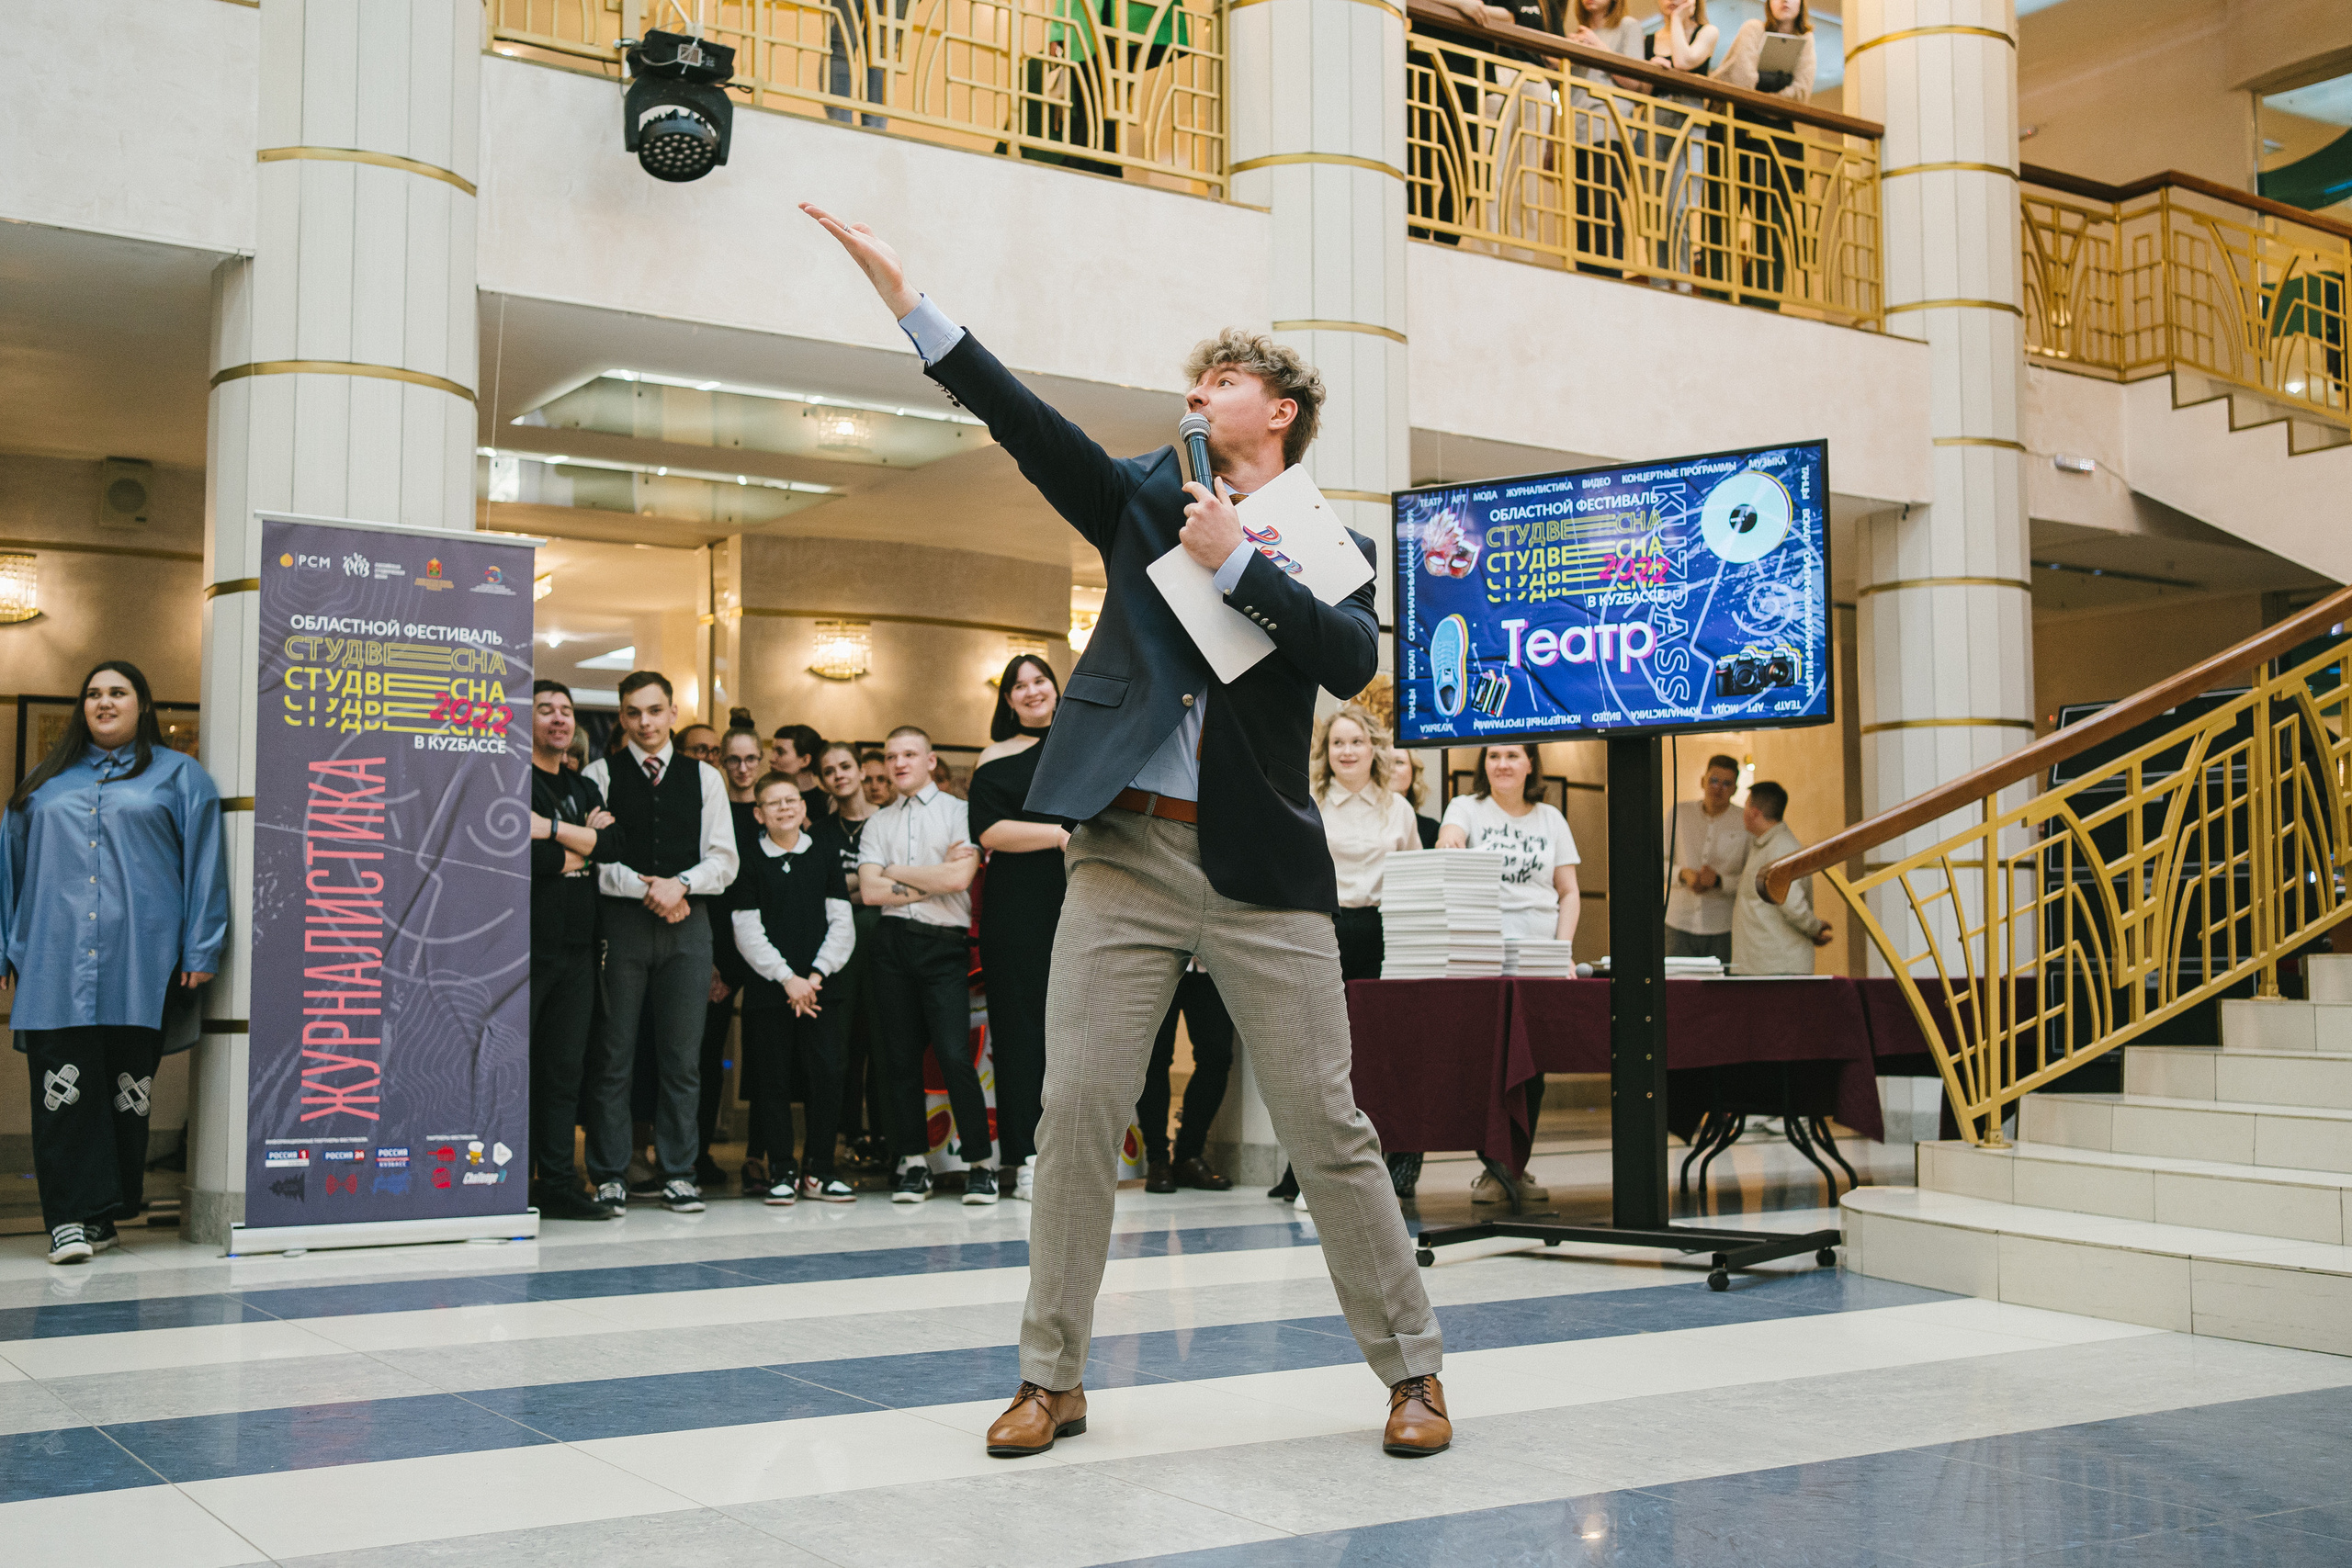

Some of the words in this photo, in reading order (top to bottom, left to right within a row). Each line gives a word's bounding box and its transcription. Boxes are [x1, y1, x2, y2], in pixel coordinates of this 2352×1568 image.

[1419, 497, 1443, 507] ТЕАТР
[1451, 494, 1466, 504] АРТ
[1473, 491, 1498, 502] МОДА
[1506, 481, 1573, 498] ЖУРНАЛИСТИКА
[1582, 477, 1611, 489] ВИДЕО
[1622, 469, 1679, 484] КОНЦЕРТНЫЕ
[1680, 461, 1736, 477] ПРОГРАММЫ
[1748, 456, 1787, 468] МУЗЫКА
[1801, 465, 1810, 500] ТАНЦЫ
[1489, 500, 1573, 522] ОБЛАСТНОЙ
[1576, 491, 1659, 513] ФЕСТИВАЛЬ
[1486, 509, 1664, 547] СТУДВЕСНА
[1803, 509, 1812, 542] ВОКАЛ
[299, 554, 331, 569] РСМ
[1487, 536, 1664, 573] СТУДВЕСНА
[1599, 554, 1670, 583] 2022
[1588, 595, 1596, 608] В
[1653, 482, 1690, 704] KUZBASS
[290, 615, 400, 637] ОБЛАСТНОЙ
[403, 623, 503, 646] ФЕСТИВАЛЬ
[284, 636, 507, 675] СТУДВЕСНА
[1500, 618, 1657, 673] Театр
[284, 666, 506, 704] СТУДВЕСНА
[428, 692, 514, 735] 2022
[1408, 688, 1417, 720] ТАНЦЫ
[1592, 711, 1622, 723] ВИДЕО
[1630, 705, 1702, 720] ЖУРНАЛИСТИКА
[1711, 703, 1739, 715] МОДА
[1747, 702, 1764, 713] АРТ
[1773, 700, 1802, 711] ТЕАТР
[1419, 723, 1453, 734] МУЗЫКА
[1473, 717, 1525, 730] ПРОГРАММЫ
[1526, 714, 1581, 728] КОНЦЕРТНЫЕ
[414, 735, 424, 750] В
[300, 756, 387, 1122] ЖУРНАЛИСТИКА
[268, 1151, 298, 1159] РОССИЯ
[300, 1150, 307, 1159] 1
[325, 1151, 354, 1160] РОССИЯ
[378, 1148, 409, 1157] РОССИЯ
